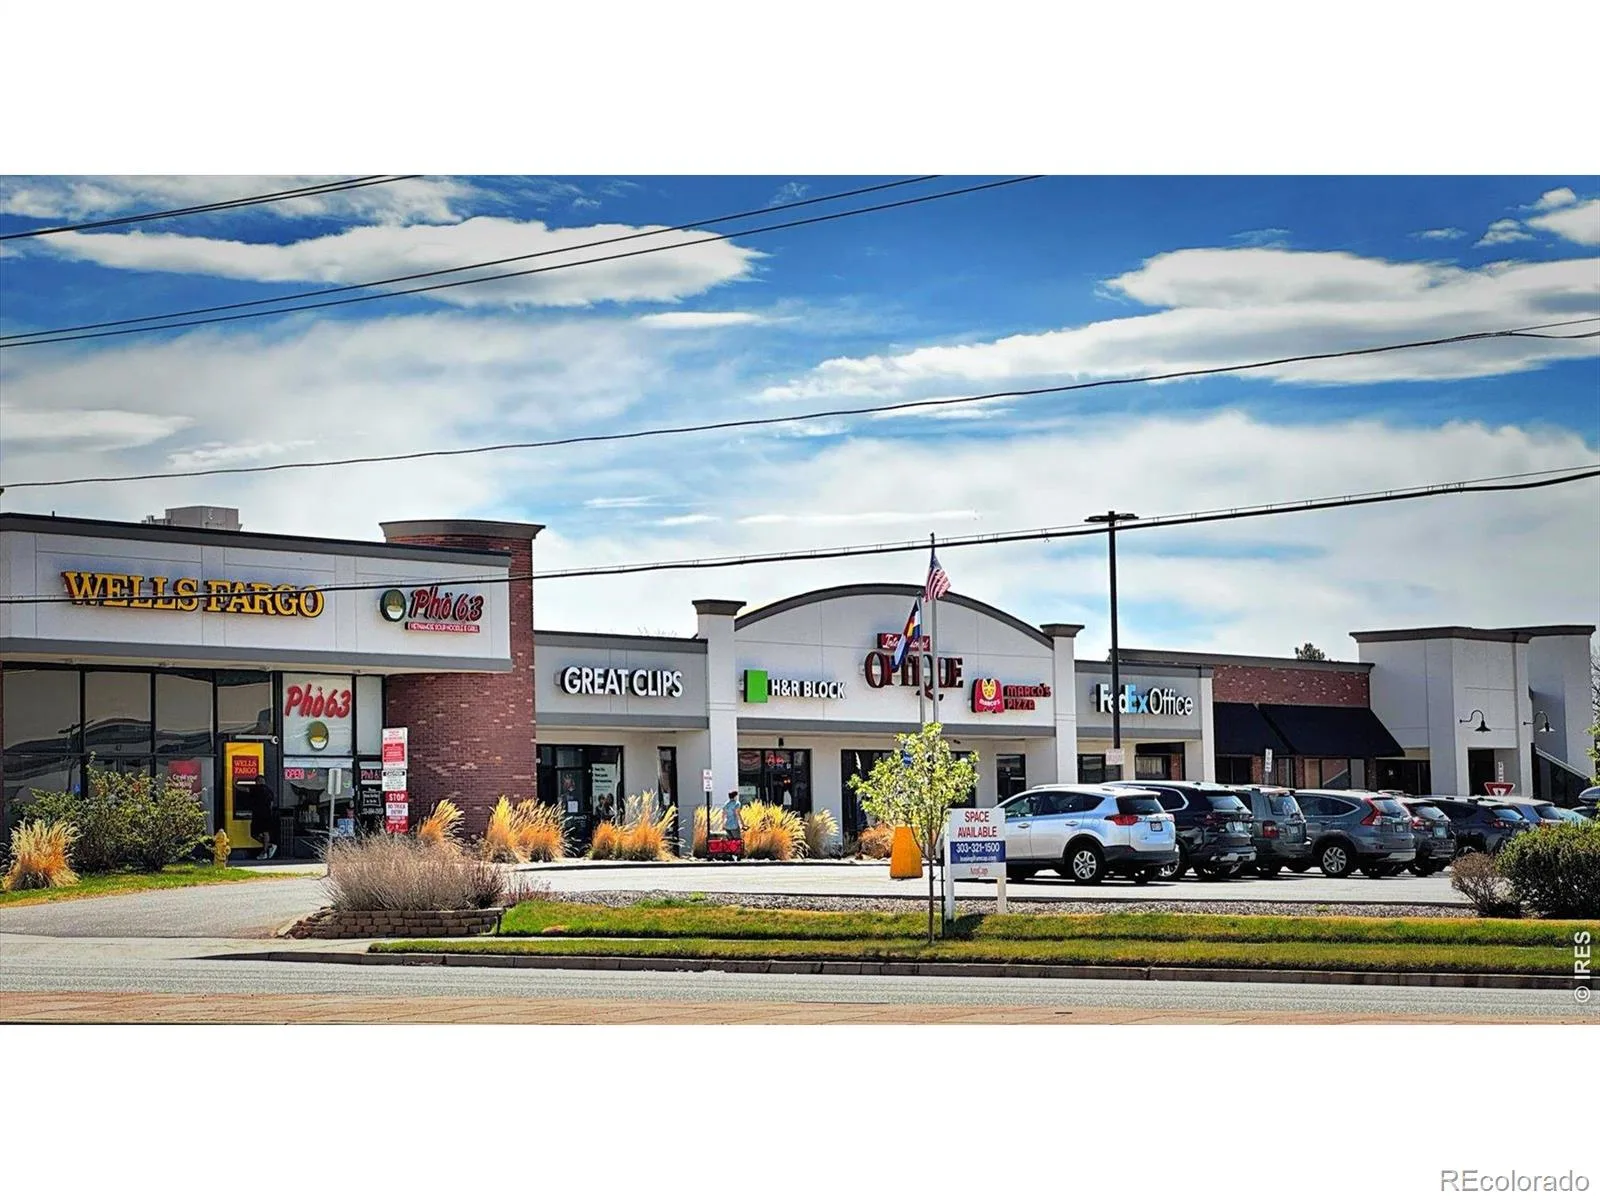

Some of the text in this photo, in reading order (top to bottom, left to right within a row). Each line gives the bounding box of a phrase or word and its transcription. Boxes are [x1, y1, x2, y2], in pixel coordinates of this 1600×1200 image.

[62, 571, 324, 618] WELLS FARGO
[453, 593, 484, 621] 63
[562, 666, 683, 698] GREAT CLIPS
[770, 678, 846, 699] H&R BLOCK
[1006, 684, 1051, 697] MARCO'S
[1007, 700, 1034, 710] PIZZA
[1149, 687, 1194, 716] Office
[389, 793, 405, 801] STOP
[965, 811, 989, 822] SPACE
[958, 826, 997, 838] AVAILABLE
[956, 842, 1000, 853] 303-321-1500
